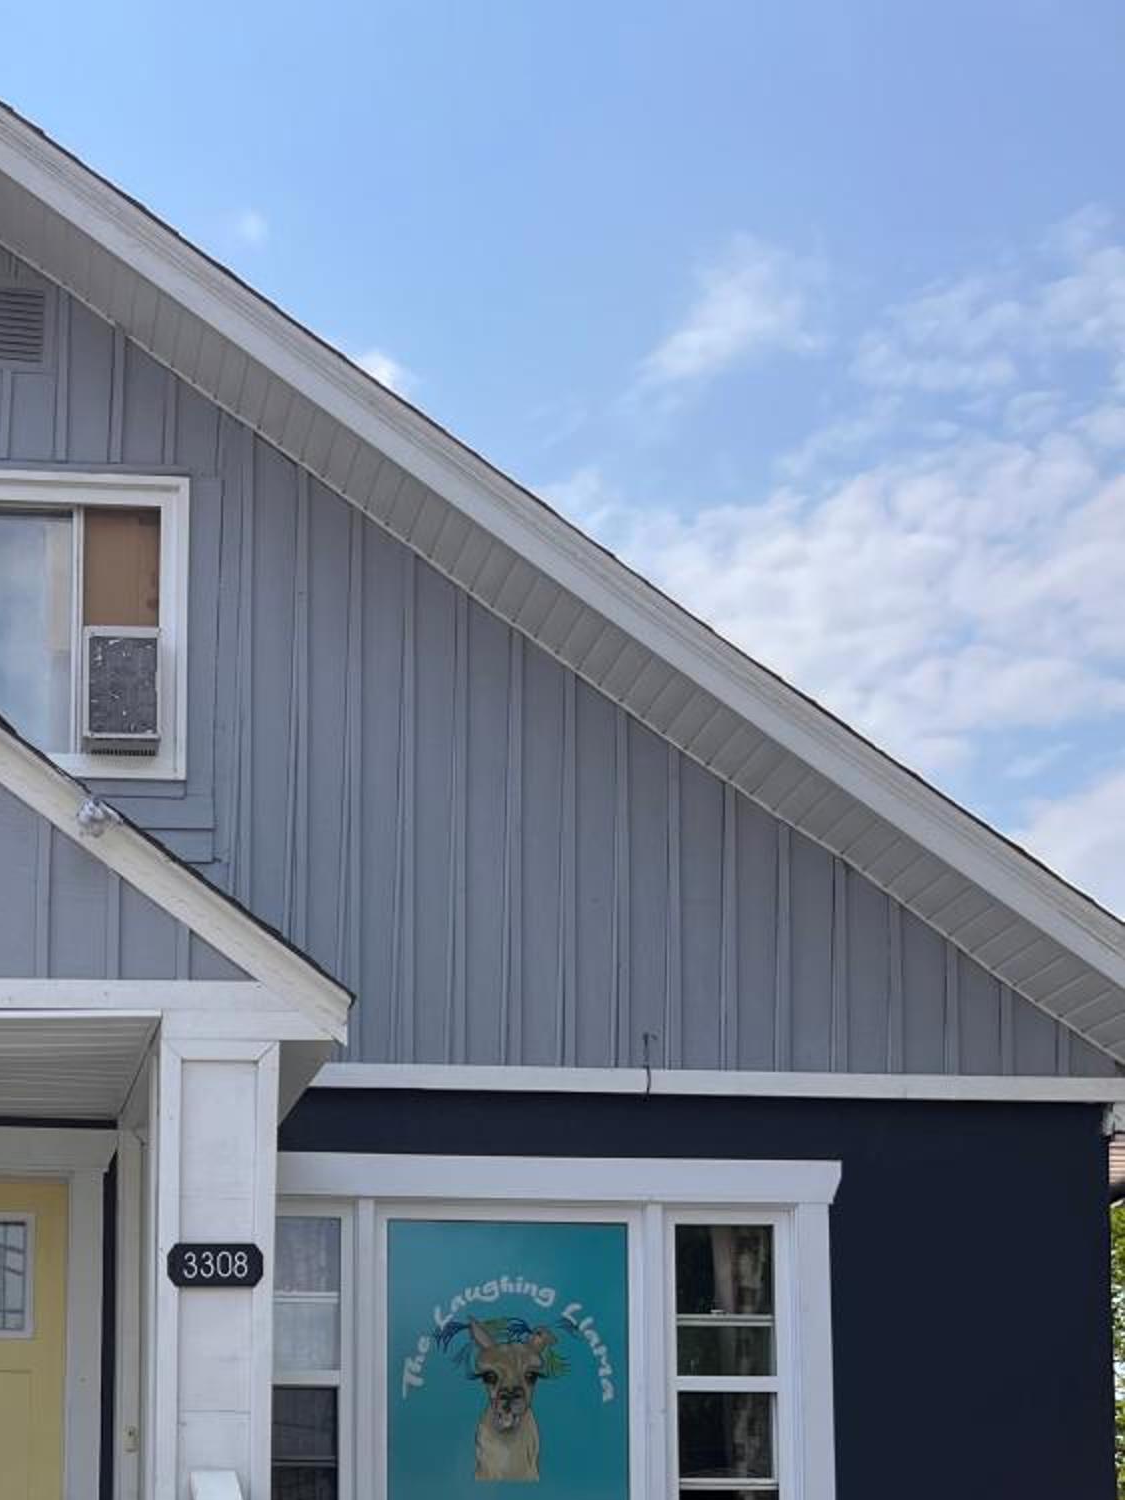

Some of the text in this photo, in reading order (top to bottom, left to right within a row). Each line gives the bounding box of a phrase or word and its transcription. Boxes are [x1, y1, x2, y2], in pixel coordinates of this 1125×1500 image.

[182, 1250, 249, 1279] 3308
[402, 1274, 615, 1402] The Laughing Llama
